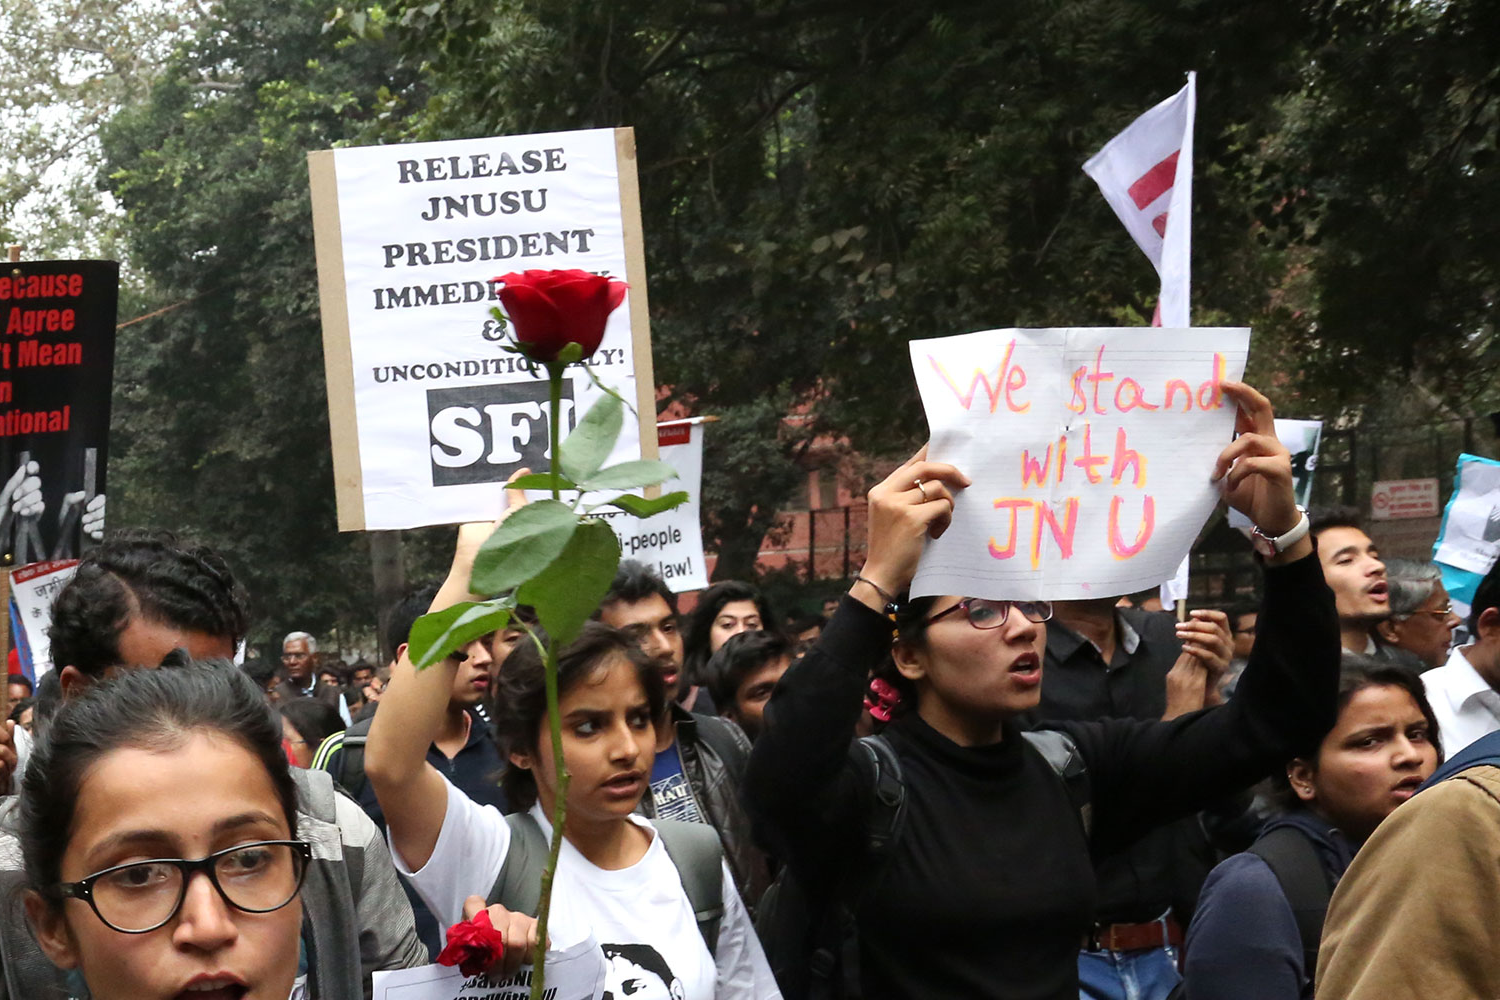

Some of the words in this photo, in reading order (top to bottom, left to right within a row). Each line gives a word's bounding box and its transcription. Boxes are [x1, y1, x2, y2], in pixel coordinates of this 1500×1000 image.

[398, 148, 566, 183] RELEASE
[422, 189, 547, 220] JNUSU
[383, 229, 594, 267] PRESIDENT
[7, 308, 74, 335] Agree
[482, 319, 507, 341] &
[18, 341, 81, 367] Mean
[927, 339, 1032, 415] We
[1066, 345, 1228, 415] stand
[1021, 419, 1148, 490] with
